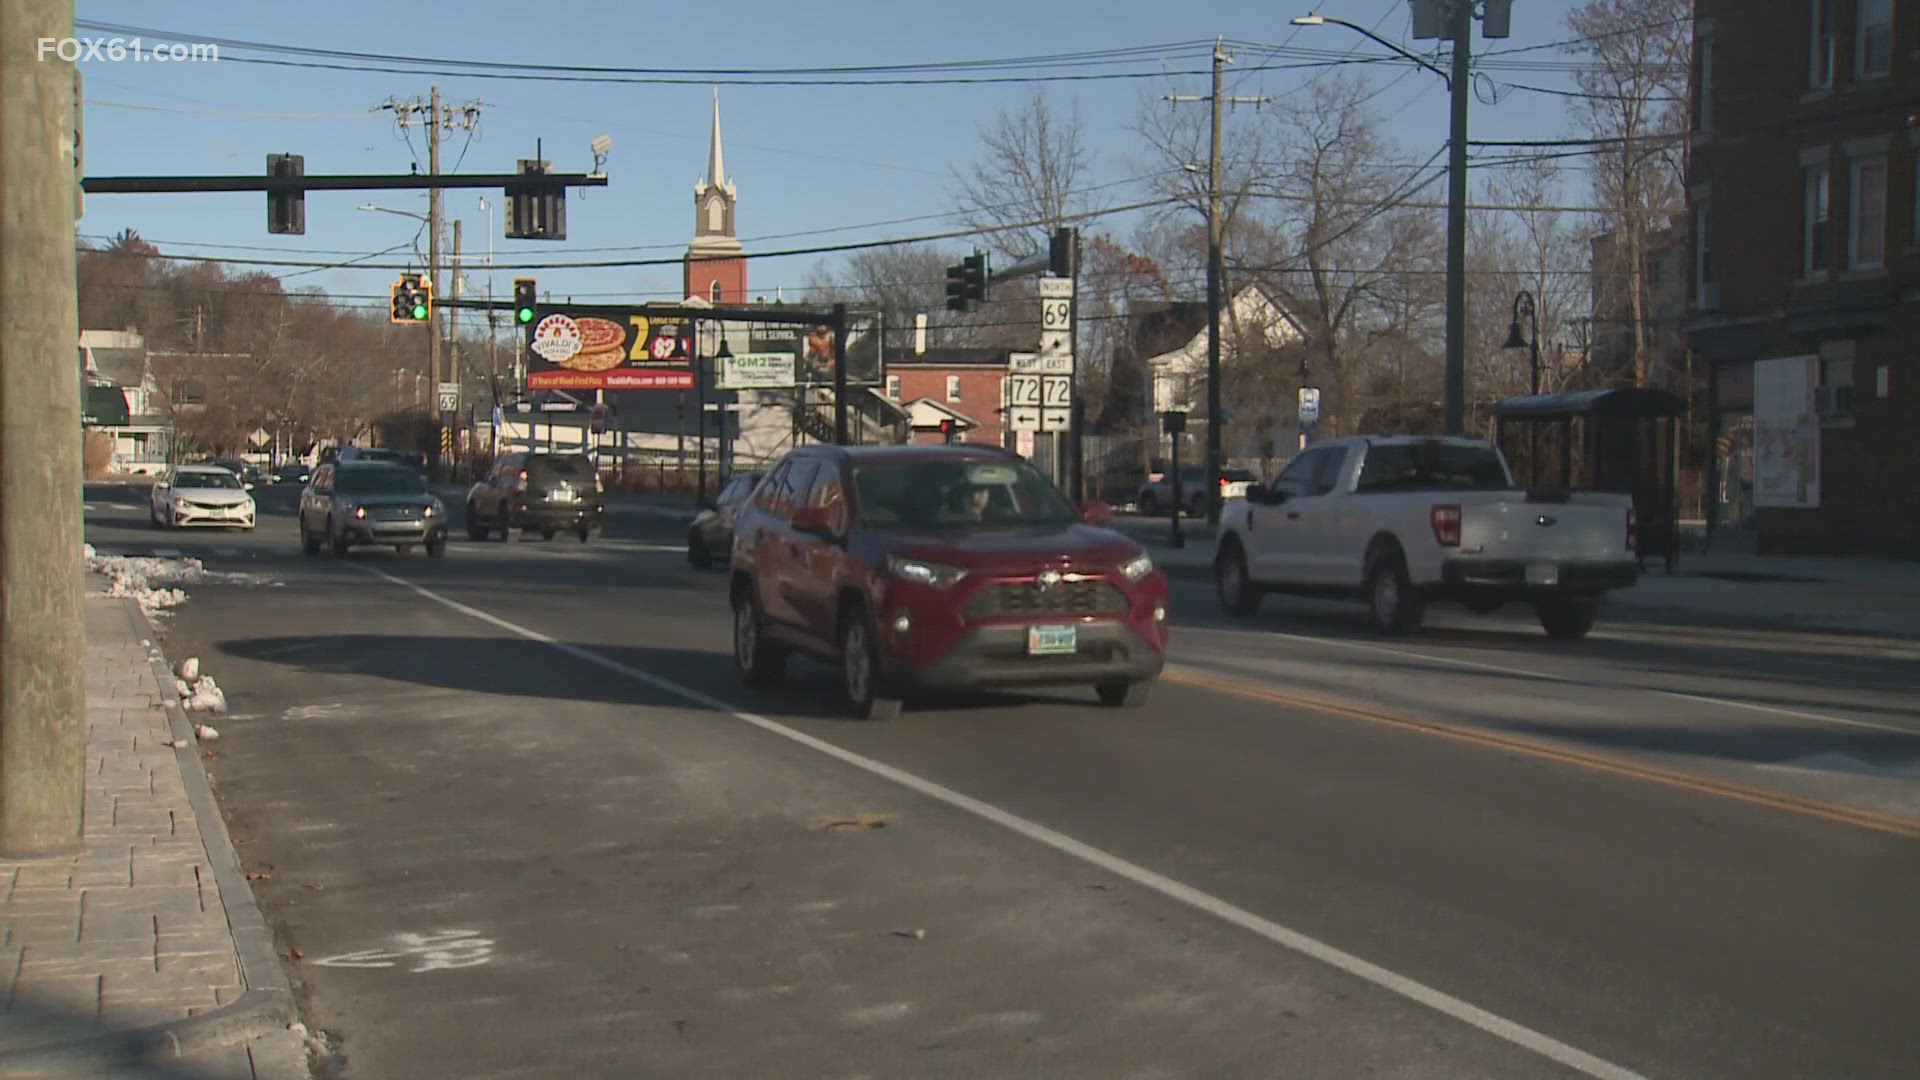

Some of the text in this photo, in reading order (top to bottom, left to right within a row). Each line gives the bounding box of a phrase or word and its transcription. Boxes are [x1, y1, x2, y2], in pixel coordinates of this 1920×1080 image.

[1043, 303, 1069, 325] 69
[534, 339, 580, 351] VIVALDI'S
[630, 315, 650, 360] 2
[737, 357, 767, 368] GM2
[1046, 359, 1067, 369] EAST
[1014, 379, 1038, 401] 72
[1045, 380, 1069, 402] 72
[441, 396, 456, 408] 69
